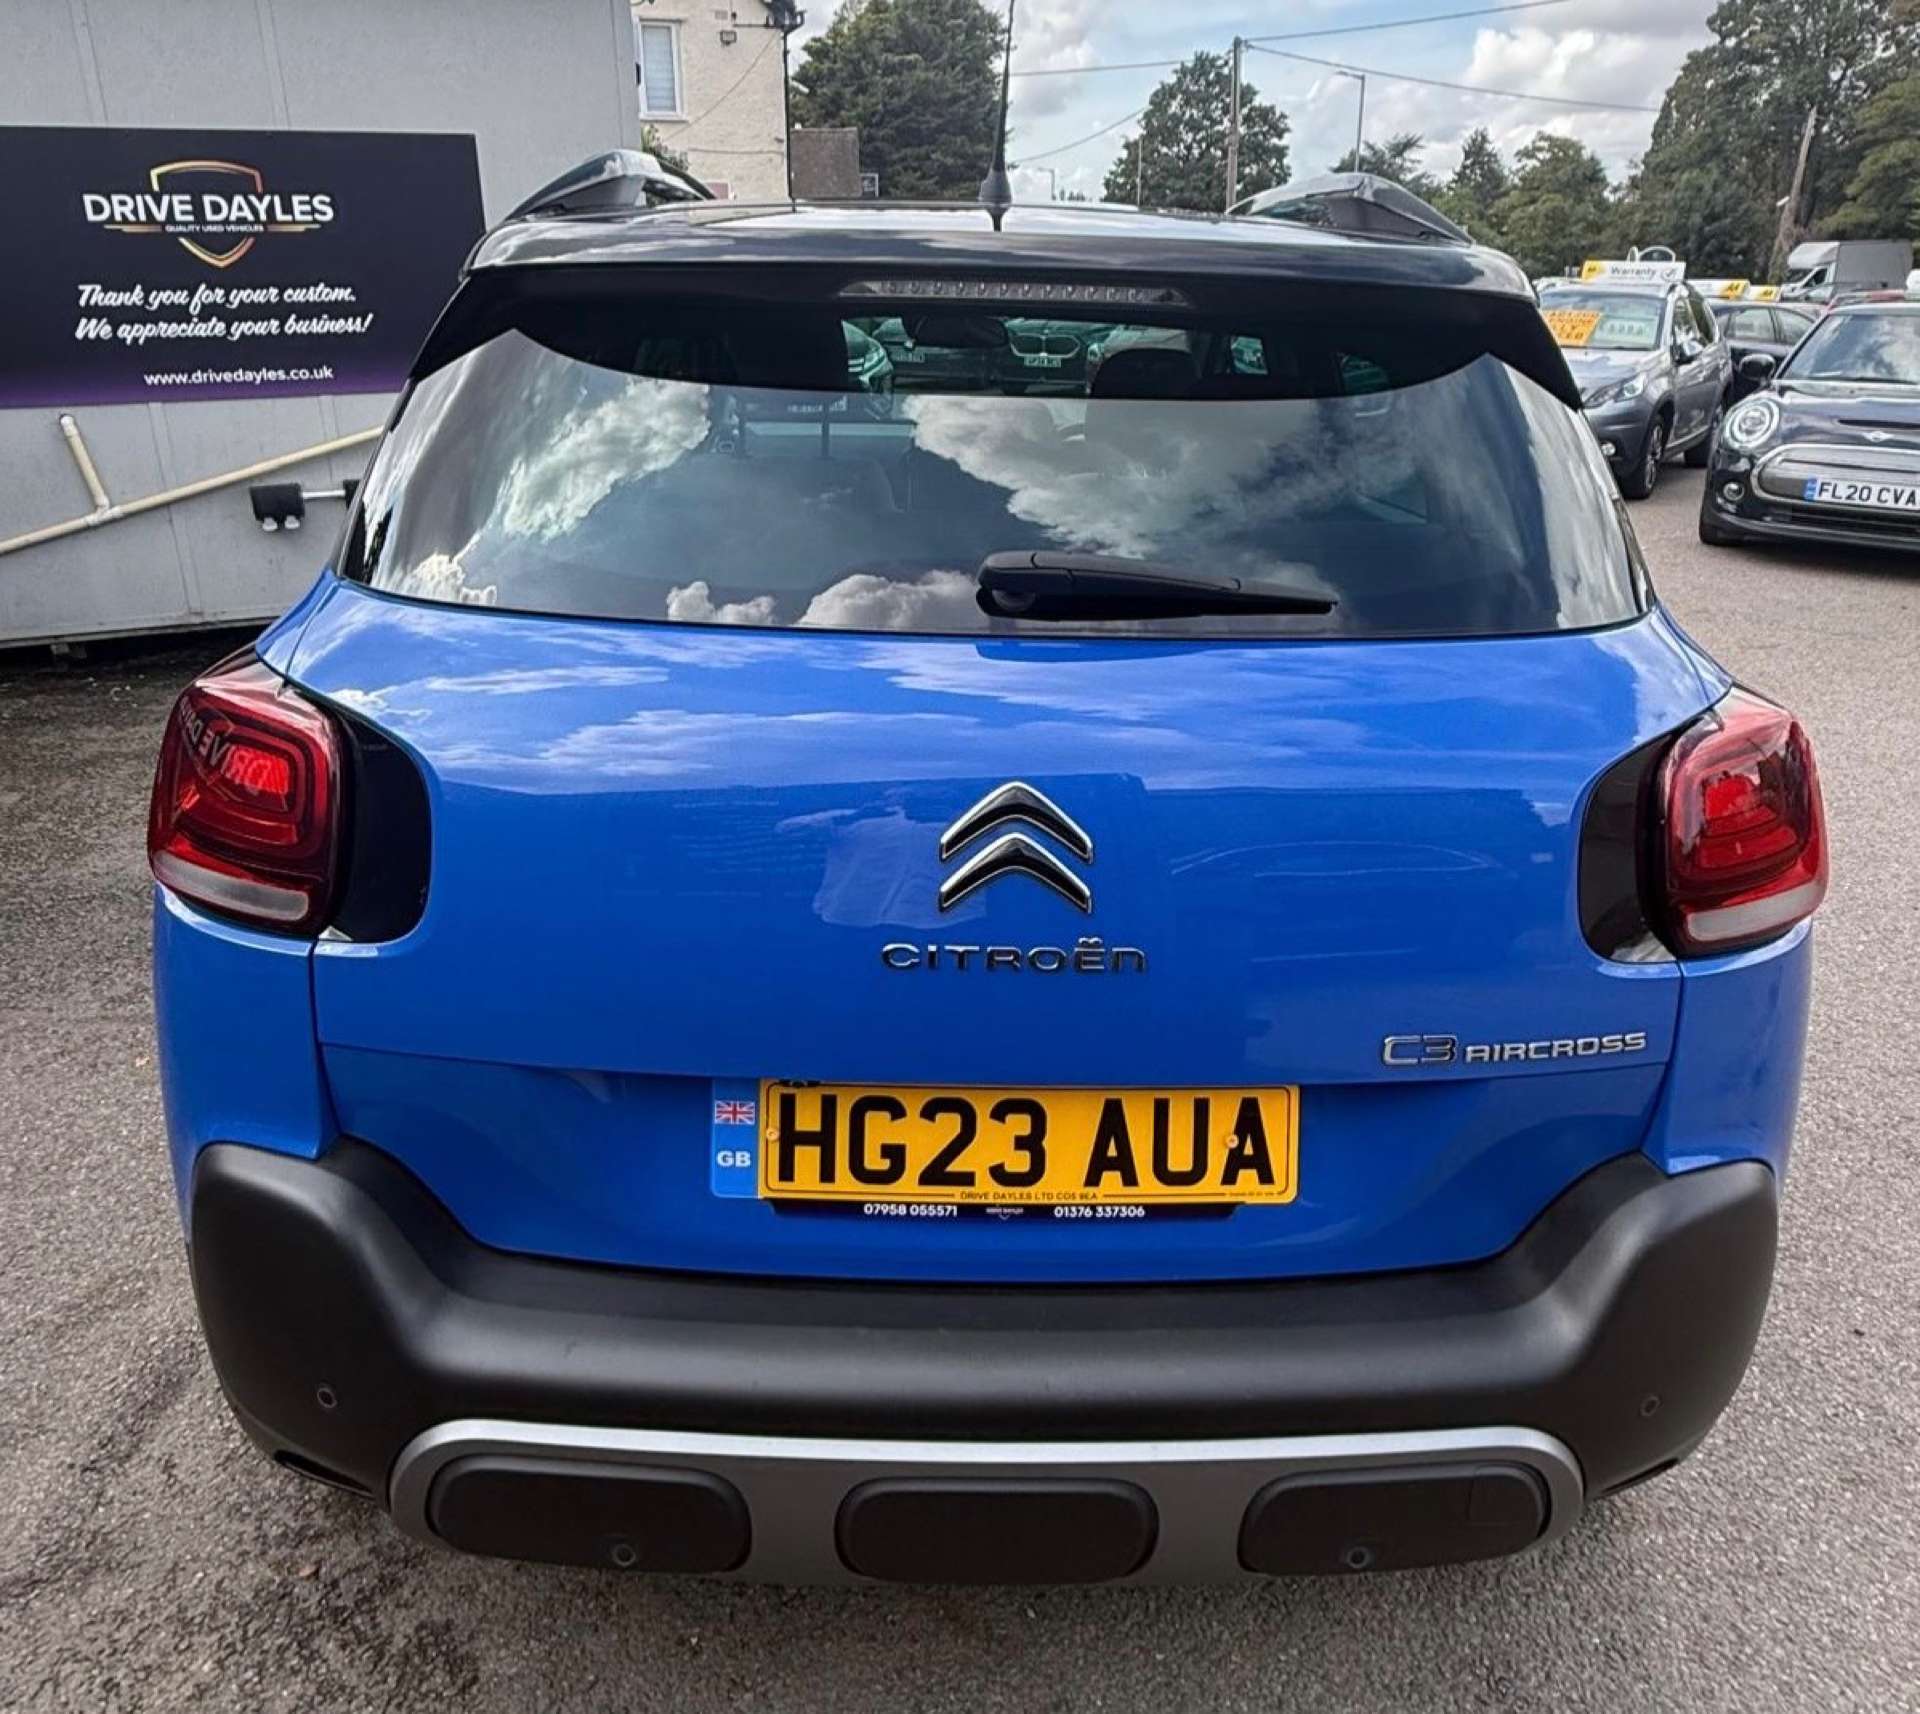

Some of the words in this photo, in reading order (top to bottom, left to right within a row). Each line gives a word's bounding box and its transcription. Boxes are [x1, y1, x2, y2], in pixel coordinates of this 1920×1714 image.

[82, 193, 195, 222] DRIVE
[202, 194, 334, 222] DAYLES
[165, 224, 200, 232] QUALITY
[1611, 266, 1656, 277] Warranty
[77, 283, 145, 307] Thank
[145, 289, 189, 311] you
[188, 283, 225, 315] for
[225, 286, 279, 309] your
[283, 282, 356, 302] custom.
[75, 317, 113, 340] We
[116, 317, 227, 346] appreciate
[226, 320, 281, 341] your
[284, 313, 374, 335] business!
[143, 364, 334, 386] www.drivedayles.co.uk
[1818, 481, 1873, 503] FL20
[1876, 486, 1917, 506] CVA
[1382, 1034, 1458, 1067] C3
[1464, 1031, 1647, 1064] AIRCROSS
[777, 1094, 1048, 1187] HG23
[1083, 1096, 1276, 1188] AUA
[717, 1150, 751, 1168] GB
[960, 1190, 990, 1200] DRIVE
[993, 1190, 1032, 1200] DAYLES
[863, 1203, 907, 1216] 07958
[909, 1204, 958, 1217] 055571
[1054, 1206, 1093, 1218] 01376
[1095, 1206, 1146, 1218] 337306
